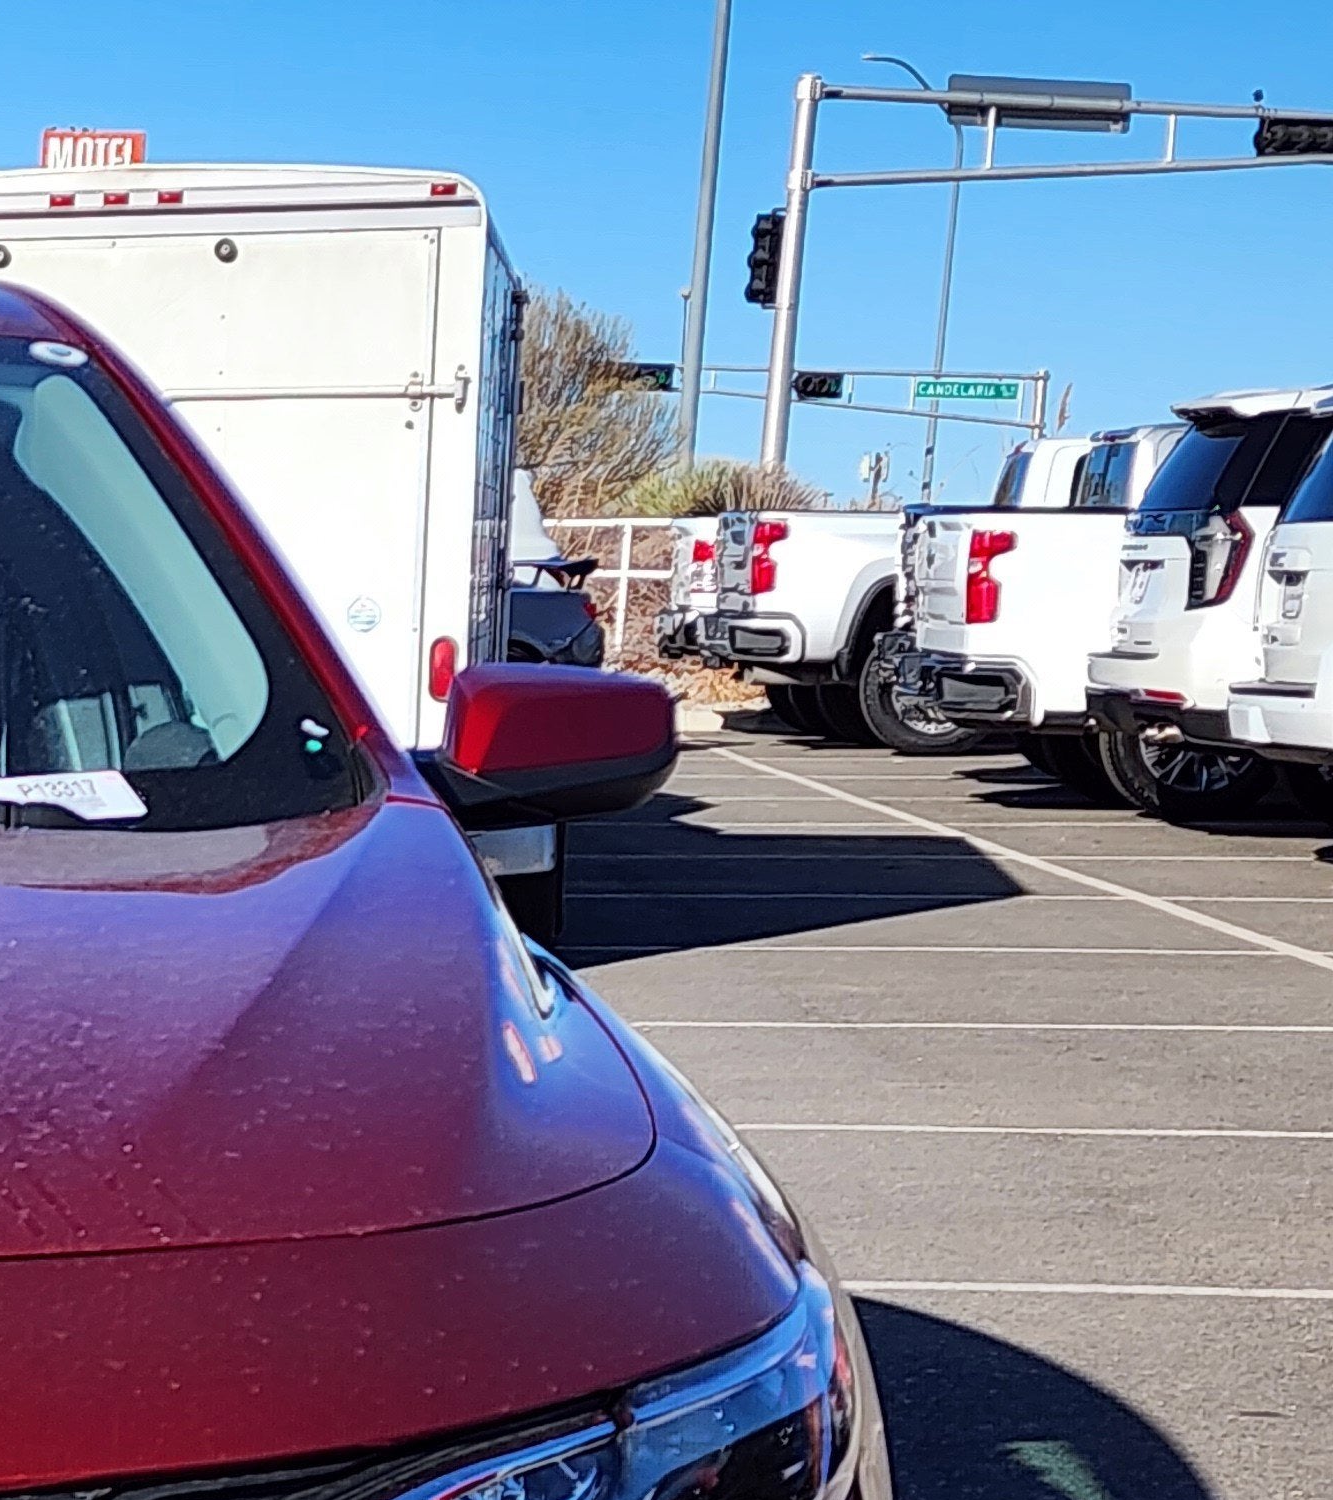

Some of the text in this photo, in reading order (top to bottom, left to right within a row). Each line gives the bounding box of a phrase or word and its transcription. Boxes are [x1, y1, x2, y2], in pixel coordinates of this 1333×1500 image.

[47, 136, 133, 169] MOTEL
[918, 383, 996, 397] CANDELARIA
[16, 778, 98, 798] P13317
